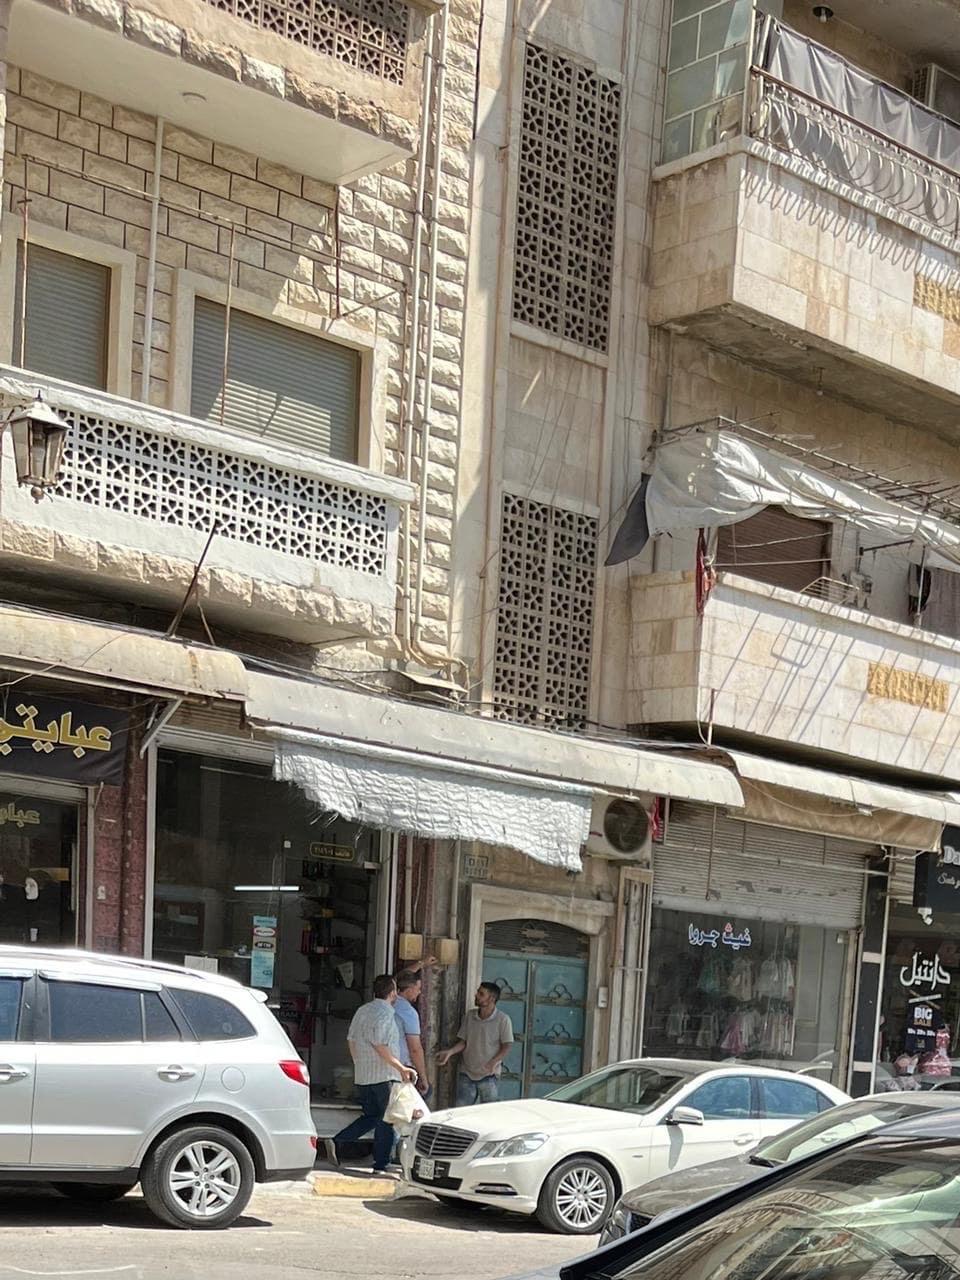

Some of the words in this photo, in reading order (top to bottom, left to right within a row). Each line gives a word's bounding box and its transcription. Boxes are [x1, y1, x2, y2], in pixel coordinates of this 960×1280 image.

[721, 922, 752, 950] غيث
[899, 951, 951, 991] دانتيل
[914, 1006, 933, 1020] BIG
